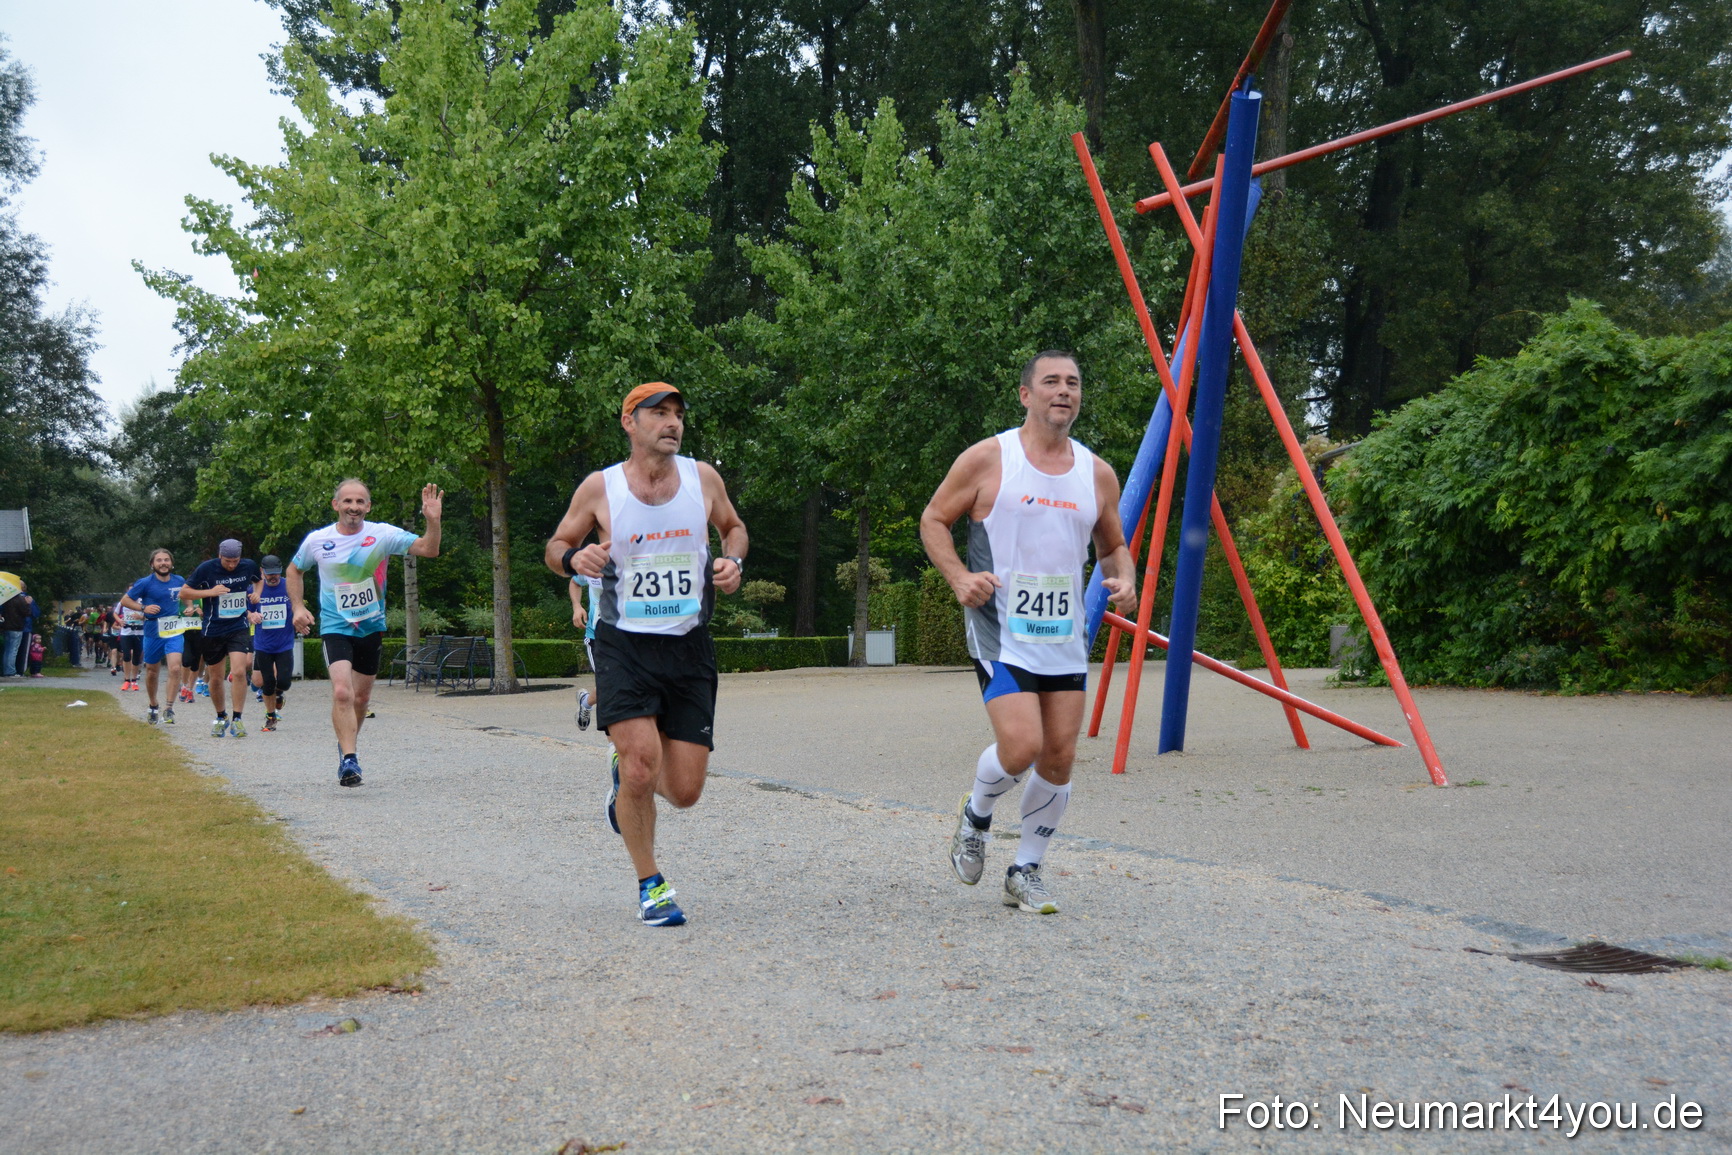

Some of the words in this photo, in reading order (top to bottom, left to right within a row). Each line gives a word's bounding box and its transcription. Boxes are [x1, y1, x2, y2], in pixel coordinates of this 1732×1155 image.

[1038, 498, 1080, 511] KLEBL
[646, 529, 693, 541] KLEBL
[655, 555, 691, 564] BOCK
[632, 570, 692, 598] 2315
[222, 598, 245, 609] 3108
[260, 596, 284, 604] CRAFT
[340, 588, 373, 609] 2280
[1016, 589, 1070, 616] 2415
[263, 609, 284, 621] 2731
[351, 608, 370, 617] Hubert
[645, 603, 681, 616] Roland
[164, 620, 178, 630] 207
[185, 620, 198, 628] 314
[1026, 622, 1060, 635] Werner
